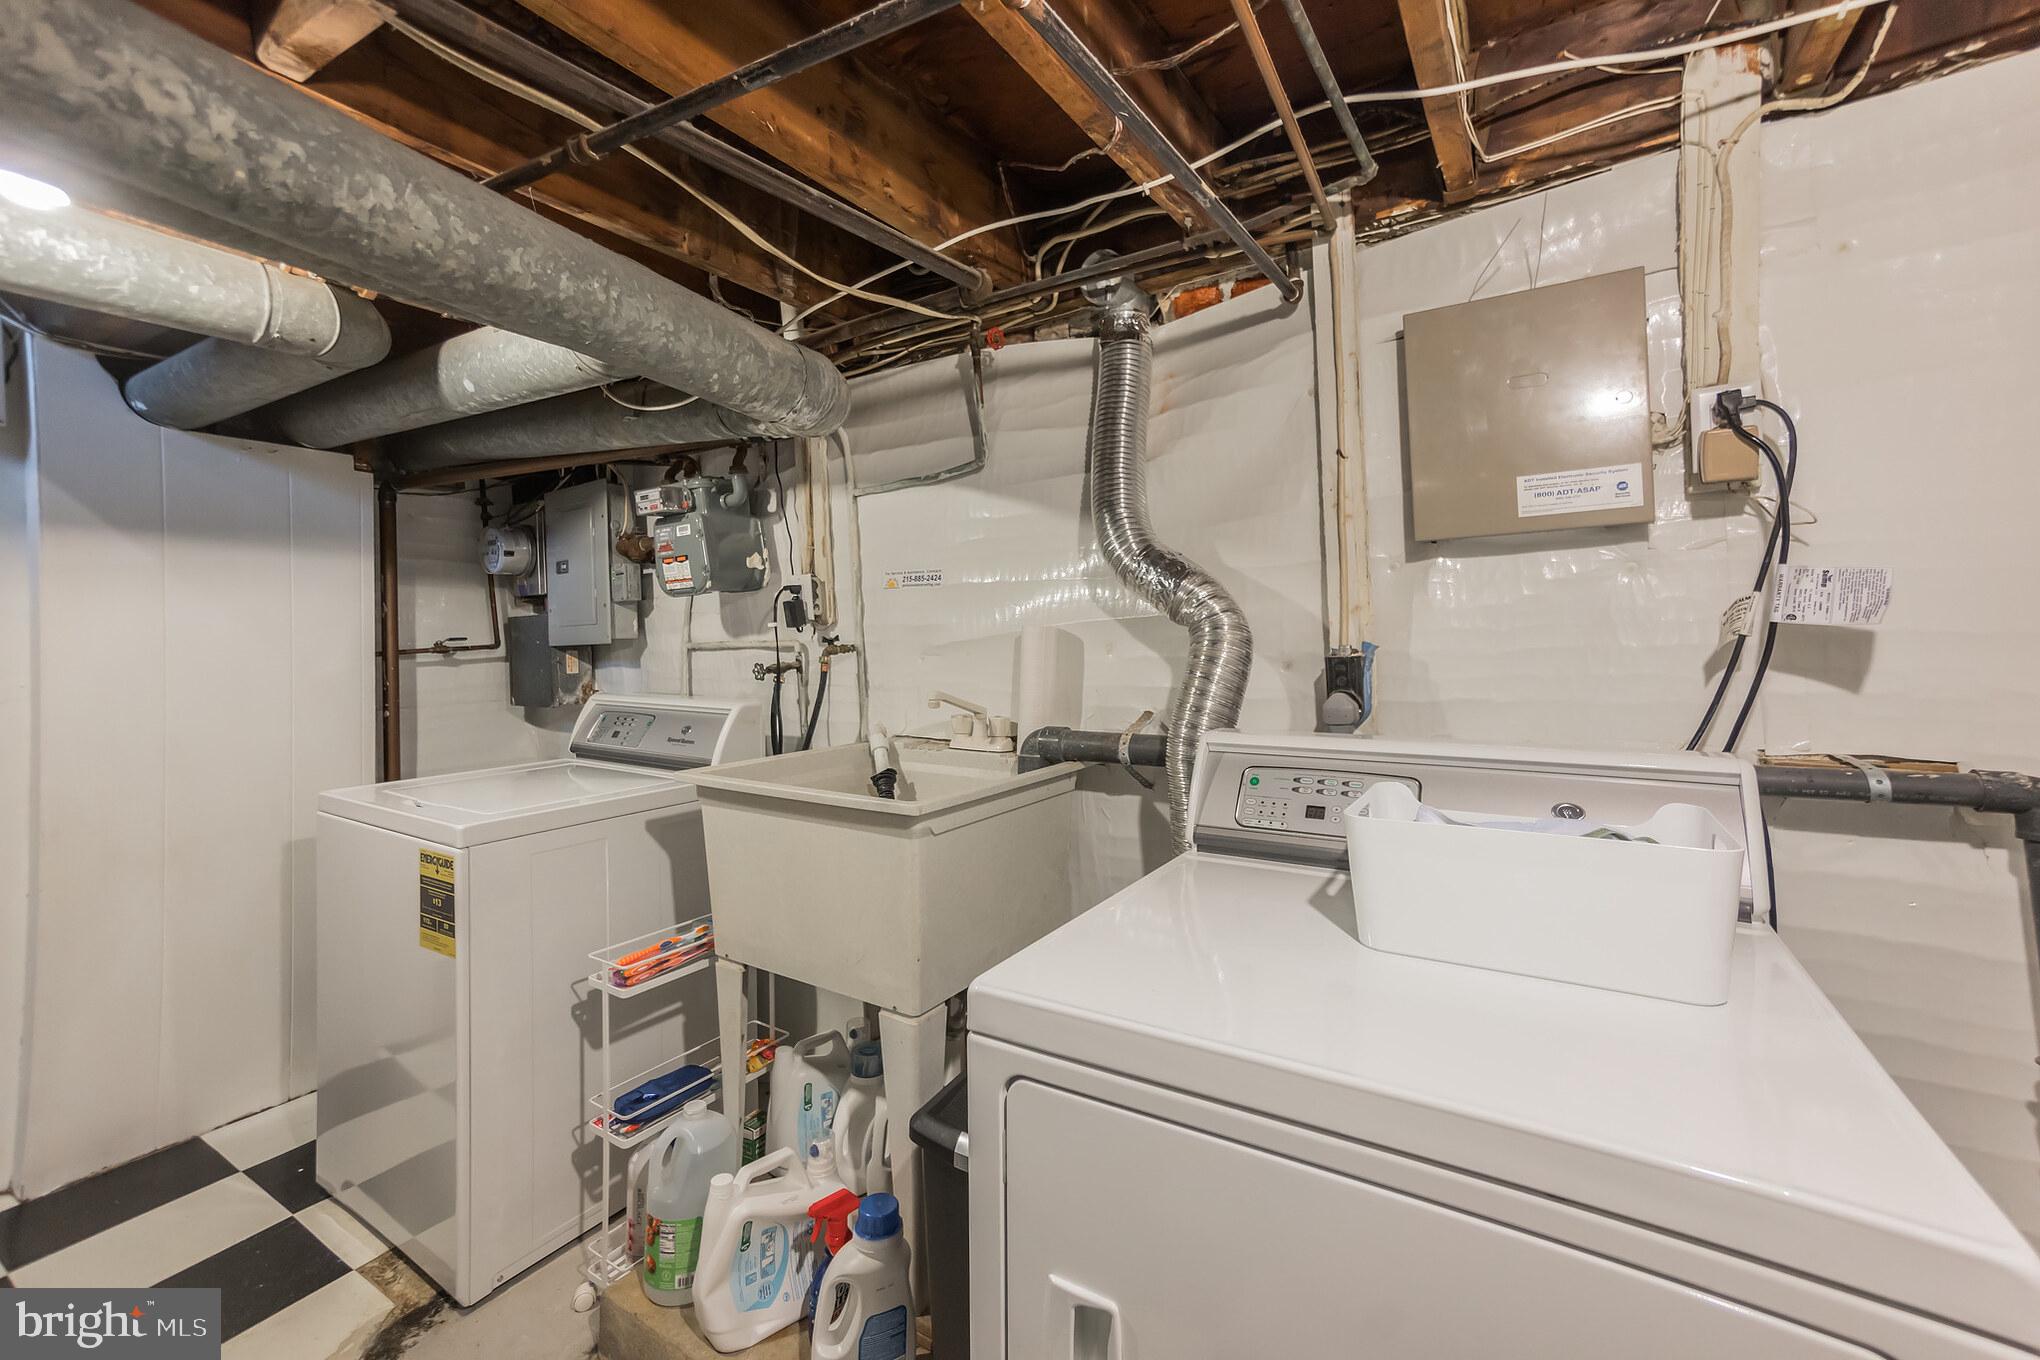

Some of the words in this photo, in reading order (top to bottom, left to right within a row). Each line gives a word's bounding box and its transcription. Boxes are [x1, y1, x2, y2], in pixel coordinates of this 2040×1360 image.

[1534, 490, 1555, 499] (800)
[1556, 485, 1601, 497] ADT-ASAP
[902, 574, 942, 583] 215-885-2424
